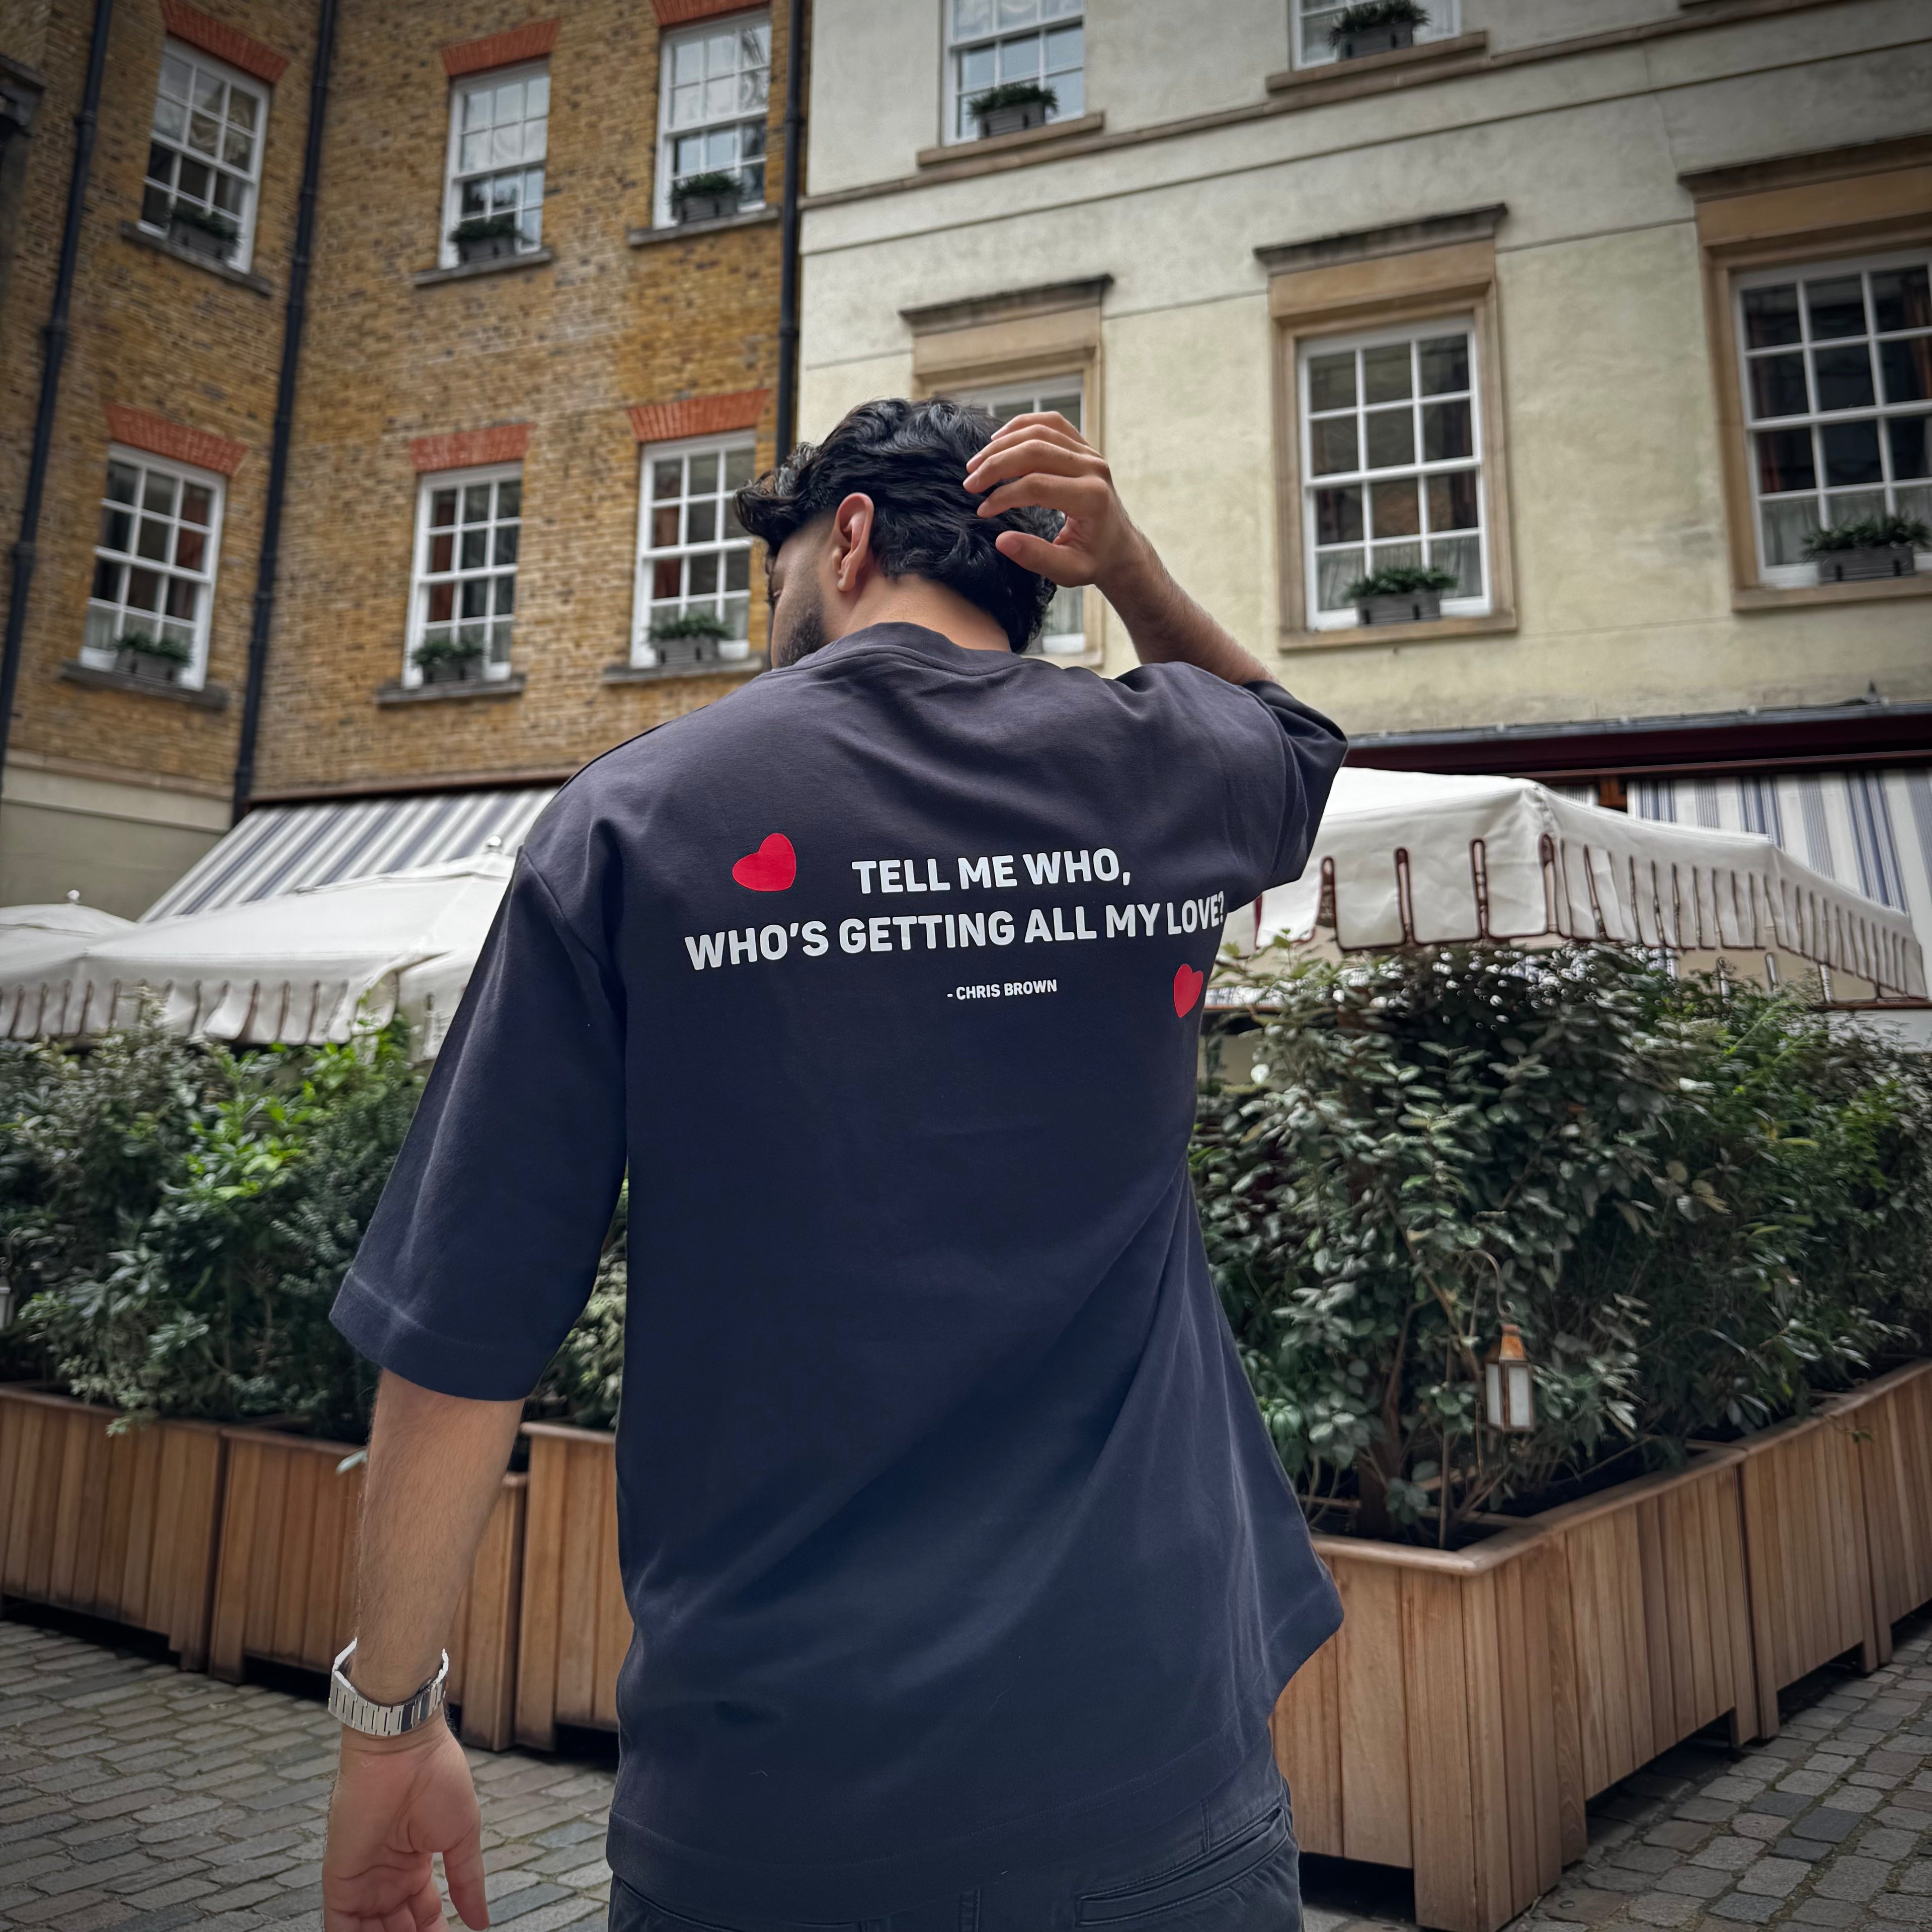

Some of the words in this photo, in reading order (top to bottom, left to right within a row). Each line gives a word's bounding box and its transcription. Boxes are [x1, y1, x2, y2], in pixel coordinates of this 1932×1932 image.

[851, 858, 951, 895] TELL
[957, 855, 1018, 890] ME
[1022, 848, 1131, 886] WHO,
[684, 921, 829, 971] WHO'S
[839, 911, 1015, 954] GETTING
[1024, 906, 1097, 944] ALL
[1105, 902, 1161, 938] MY
[1166, 890, 1225, 935] LOVE?
[1003, 979, 1058, 997] BROWN
